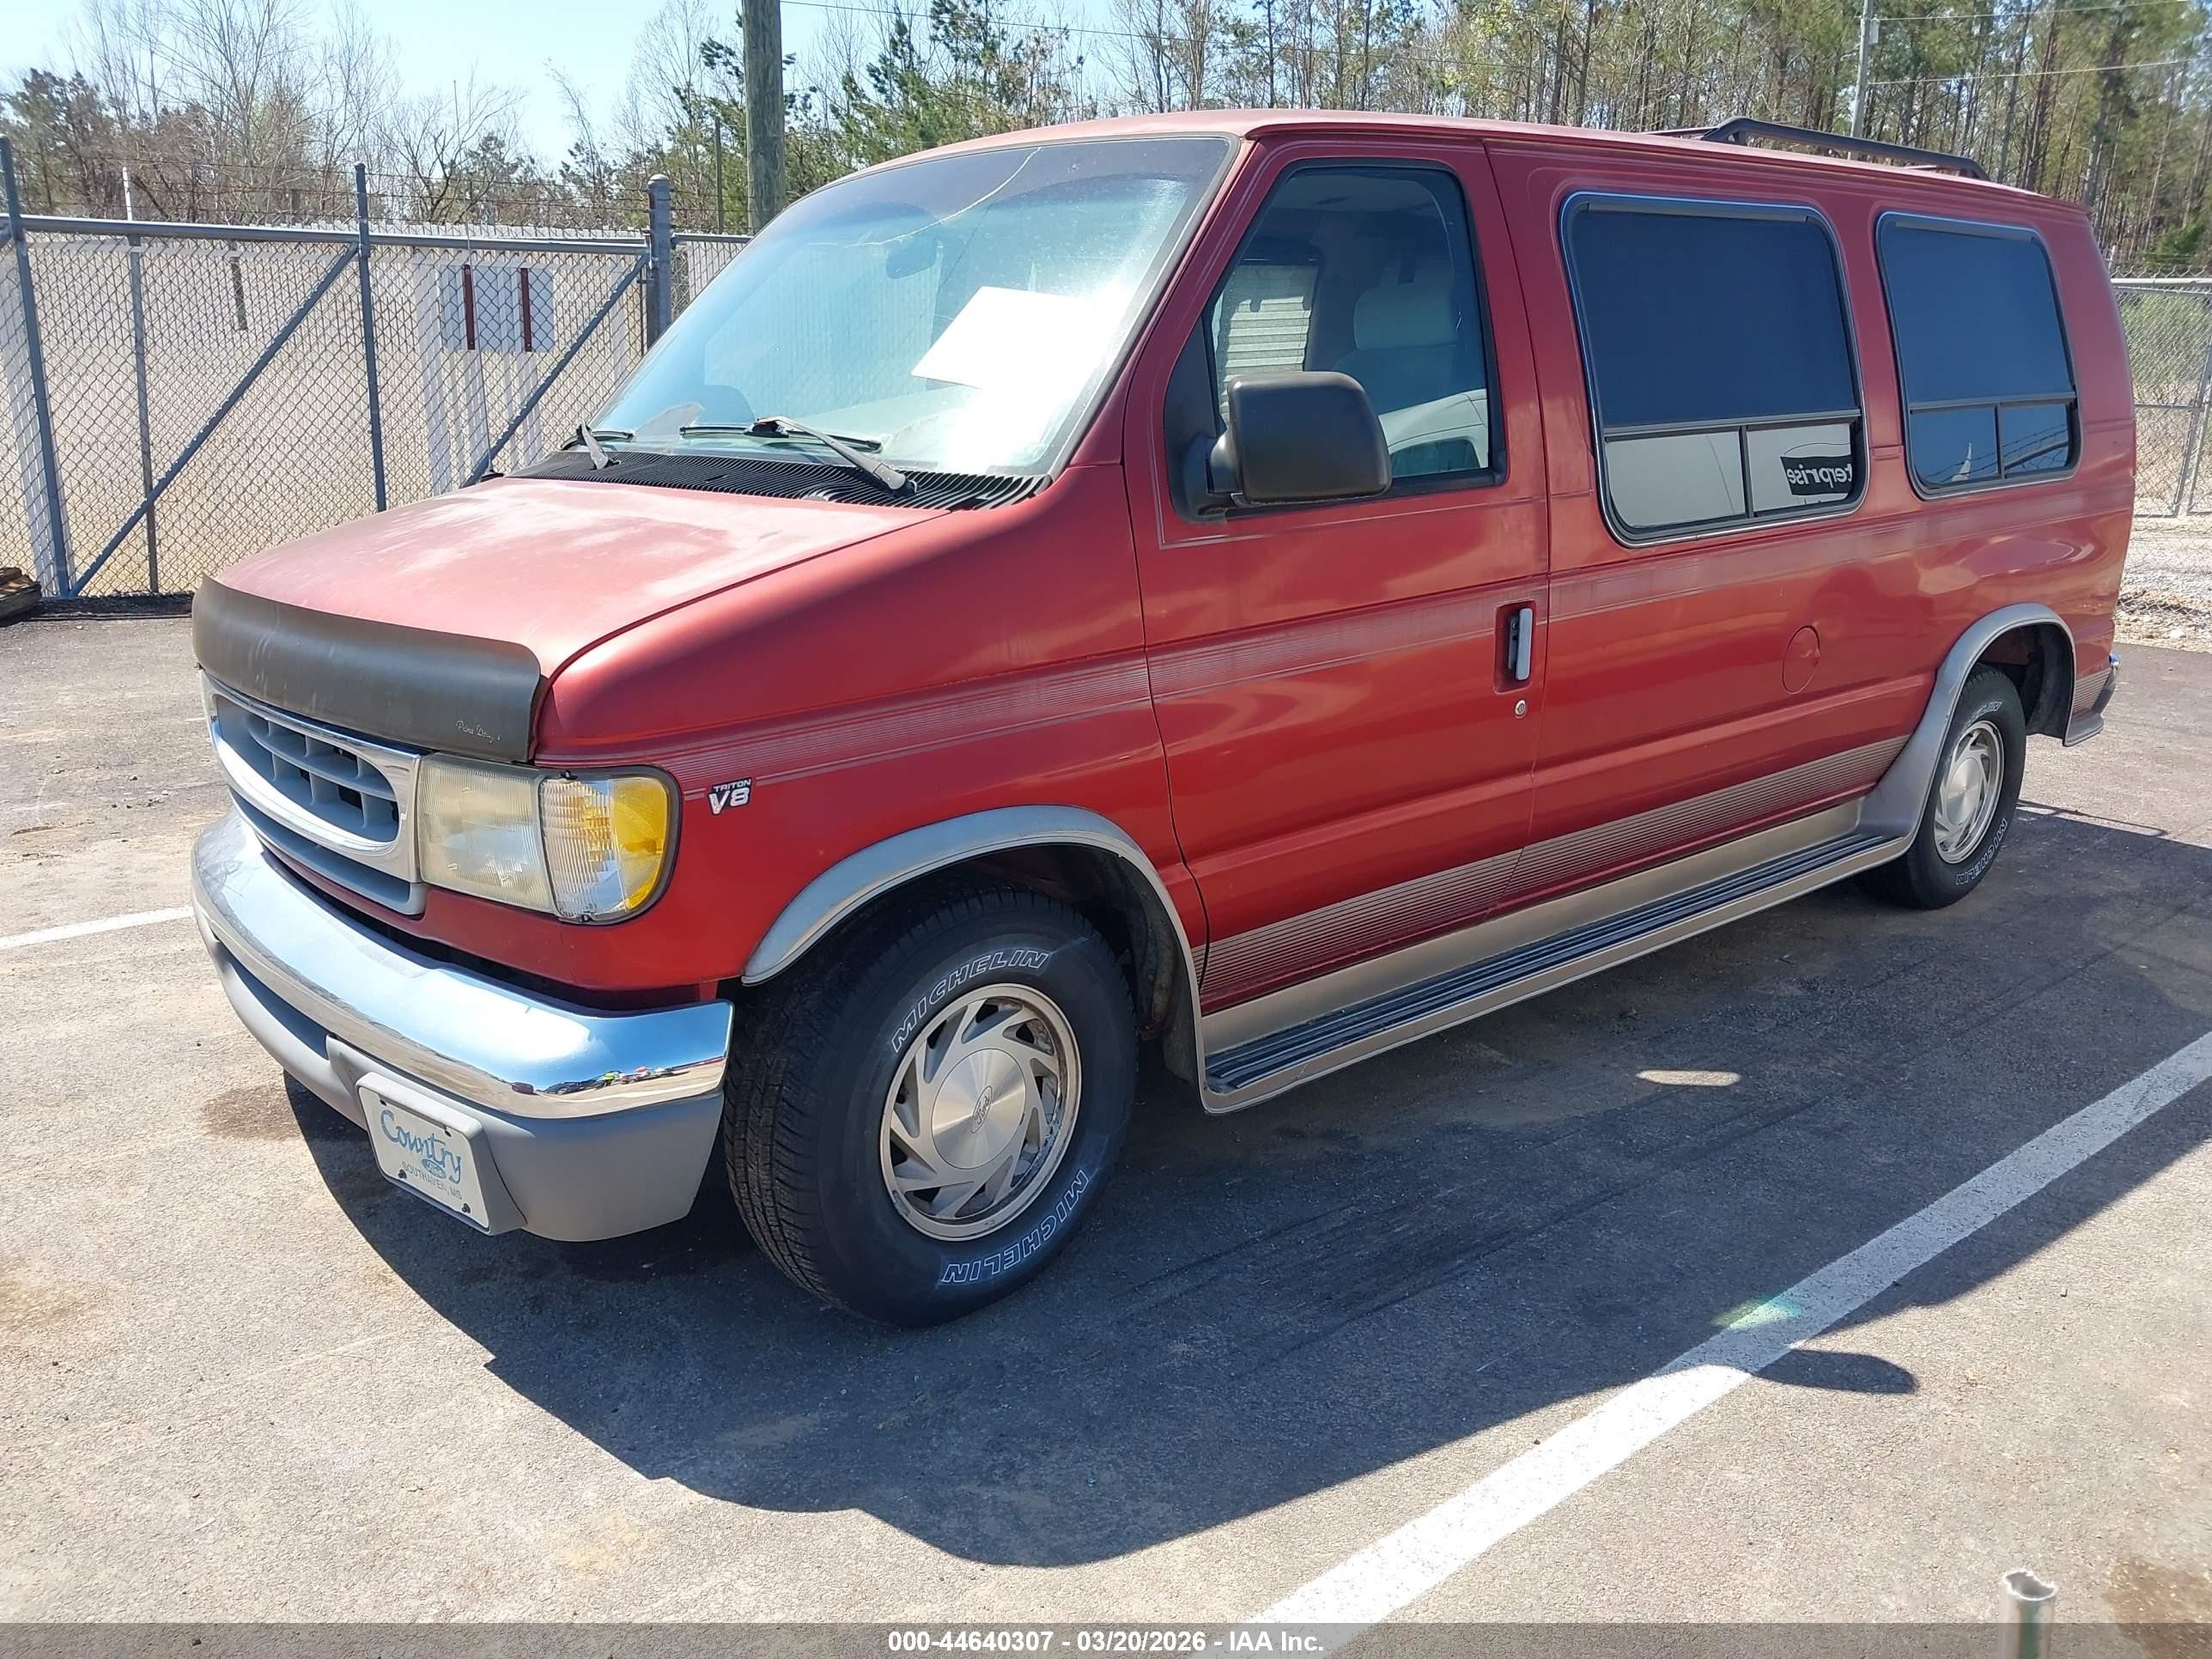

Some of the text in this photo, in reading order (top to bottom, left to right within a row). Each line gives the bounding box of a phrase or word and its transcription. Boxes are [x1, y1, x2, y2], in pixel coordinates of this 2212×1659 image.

[708, 787, 750, 815] V8
[713, 779, 751, 793] TRITON
[1956, 817, 2008, 884] MICHELIN
[891, 950, 1048, 1053] MICHELIN
[973, 1092, 991, 1127] Ford
[380, 1109, 461, 1185] Country
[941, 1170, 1089, 1282] MICHELIN
